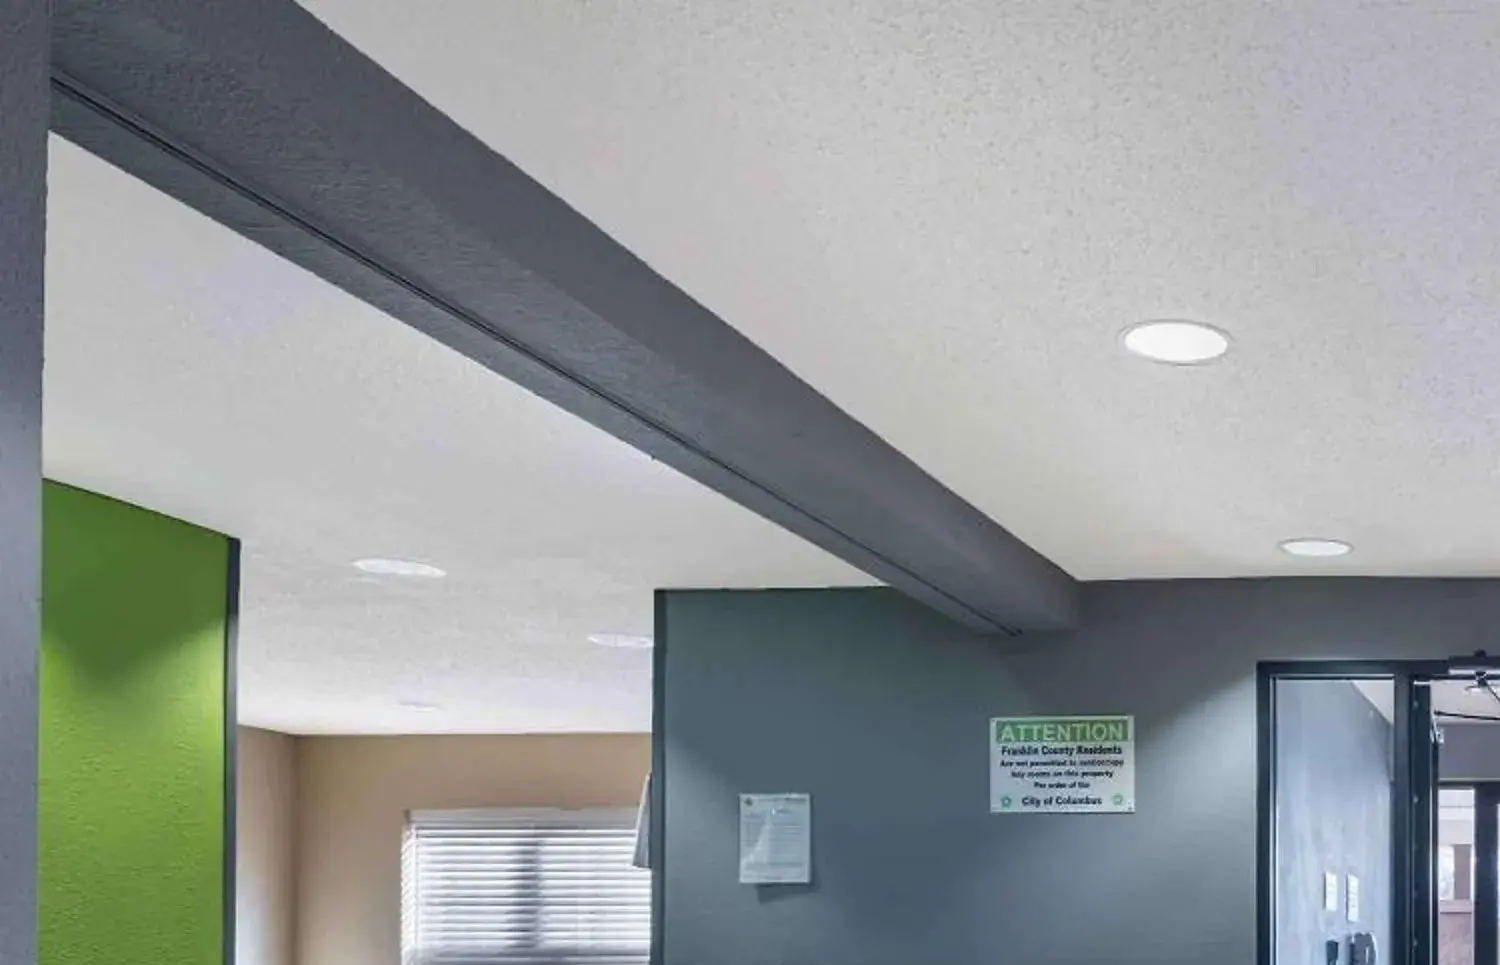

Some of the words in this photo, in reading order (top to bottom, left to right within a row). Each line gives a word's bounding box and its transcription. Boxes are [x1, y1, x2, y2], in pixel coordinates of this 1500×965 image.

[1001, 723, 1124, 742] ATTENTION
[1001, 746, 1039, 755] Franklin
[1041, 746, 1075, 757] County
[1076, 745, 1123, 755] Residents
[1021, 796, 1041, 807] City
[1043, 796, 1054, 805] of
[1055, 795, 1103, 805] Columbus
